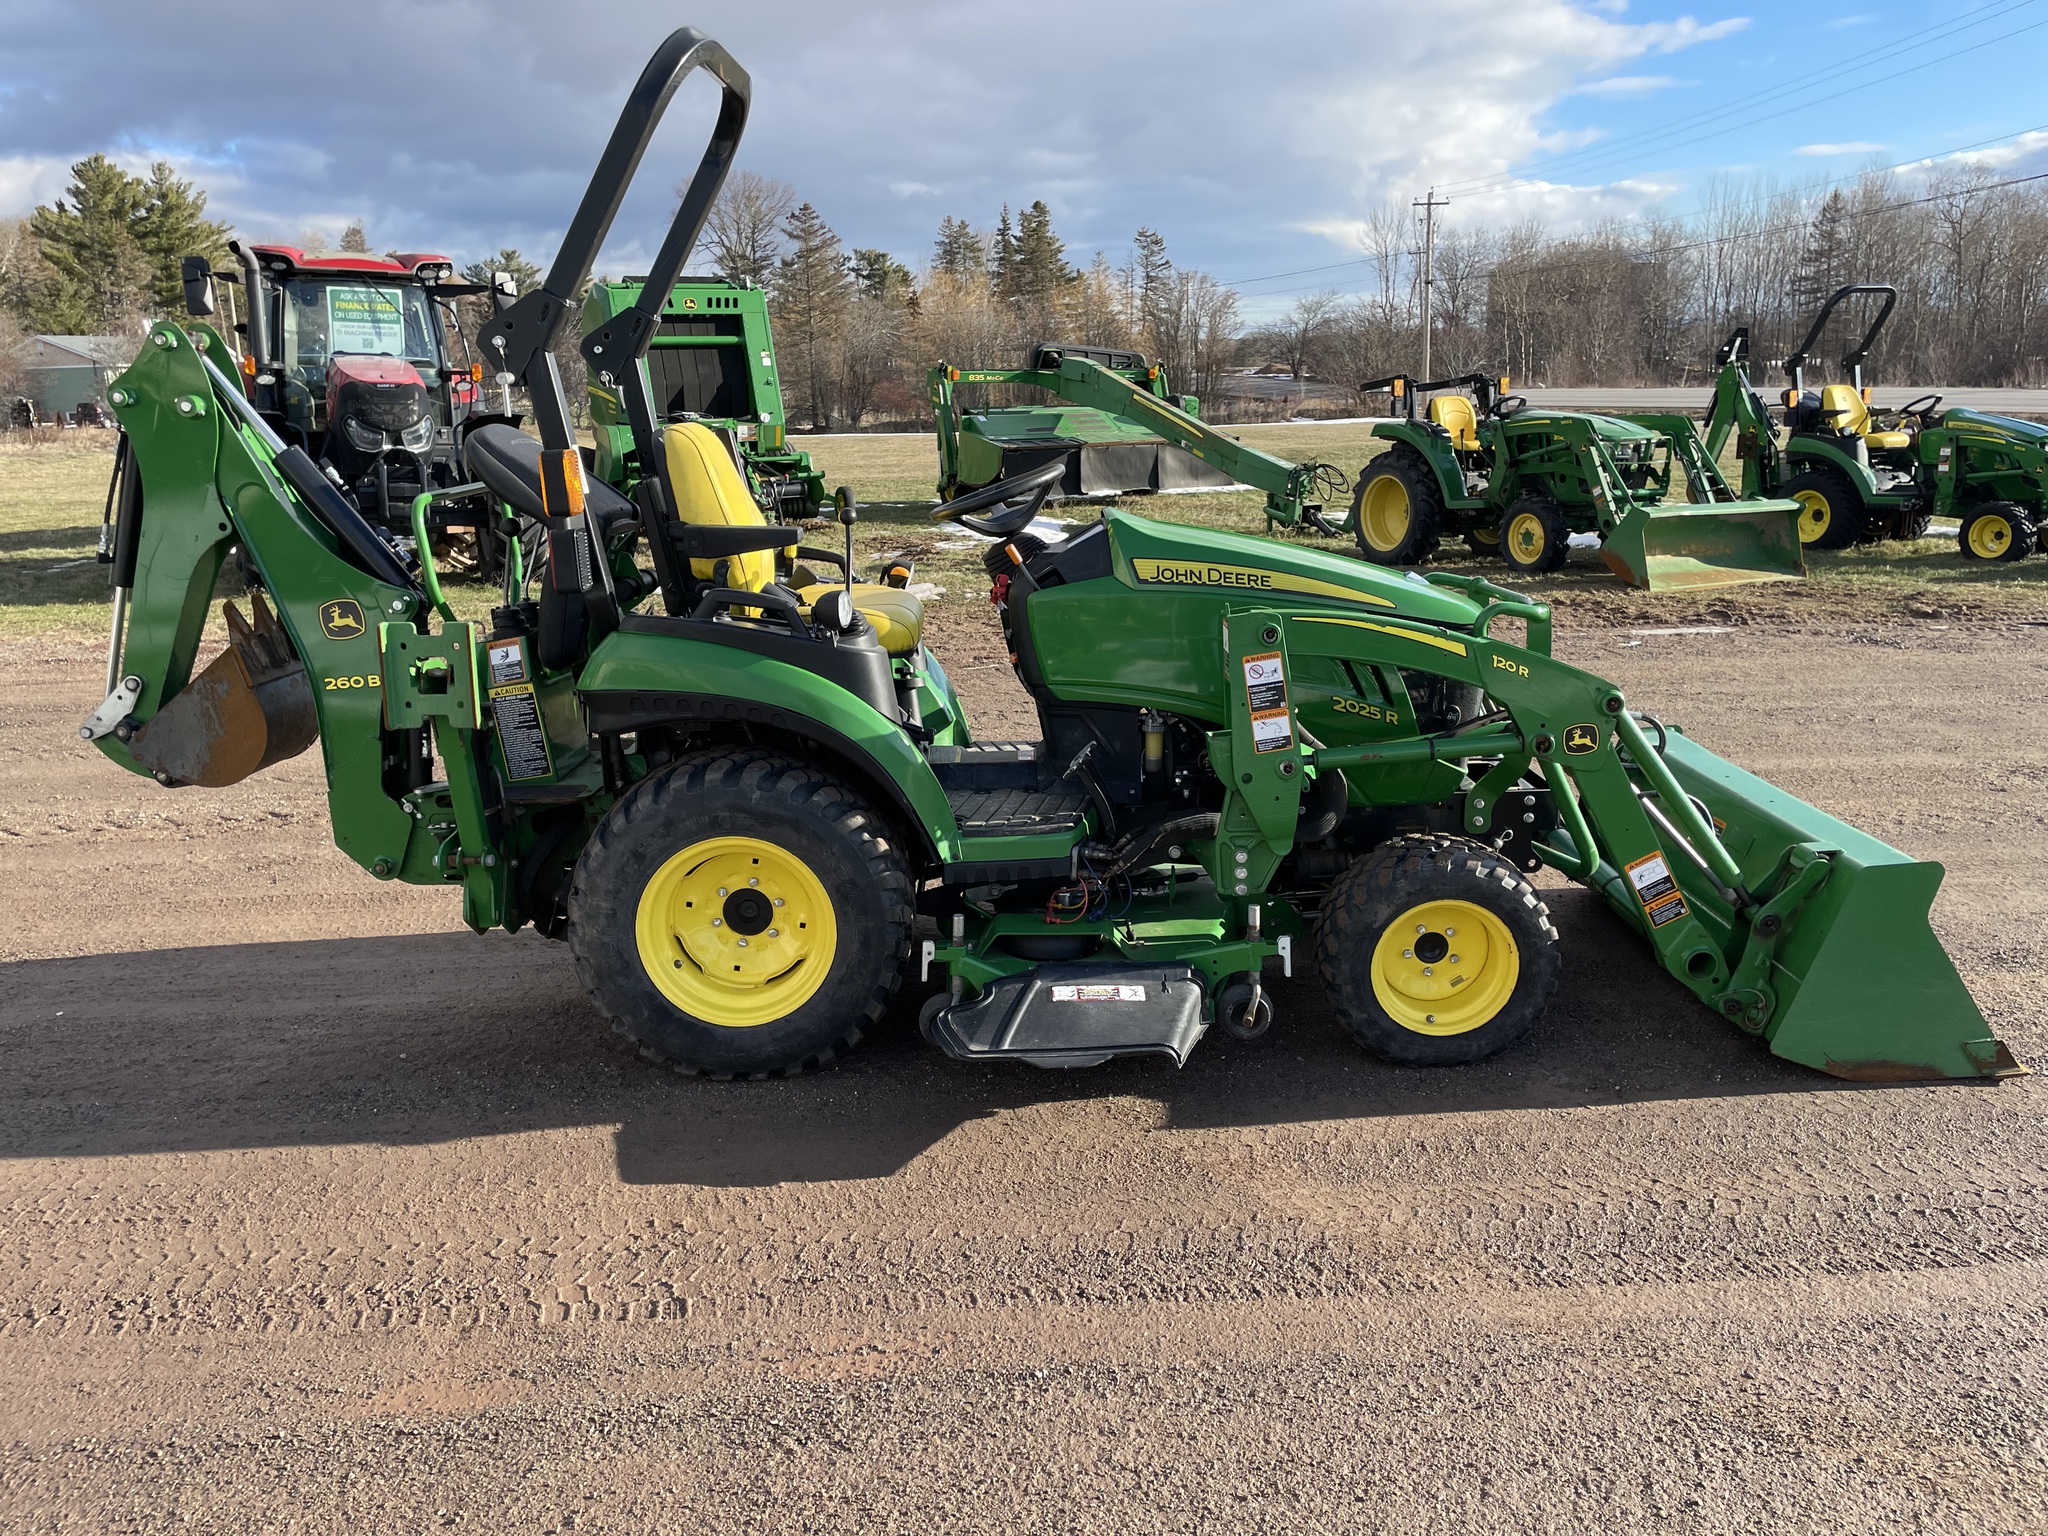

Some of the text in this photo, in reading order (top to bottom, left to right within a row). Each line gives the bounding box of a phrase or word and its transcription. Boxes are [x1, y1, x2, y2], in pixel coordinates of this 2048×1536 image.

[335, 302, 396, 311] FINANCE RATES
[364, 312, 397, 321] EQUIPMENT
[1150, 565, 1272, 588] JOHN DEERE
[1250, 652, 1280, 662] WARNING
[1492, 654, 1530, 678] 120 R
[324, 674, 381, 690] 260 B
[501, 685, 529, 696] CAUTION
[1258, 710, 1288, 720] WARNING
[1333, 696, 1399, 726] 2025 R
[1633, 853, 1658, 867] WARNING
[1655, 894, 1678, 908] WARNING
